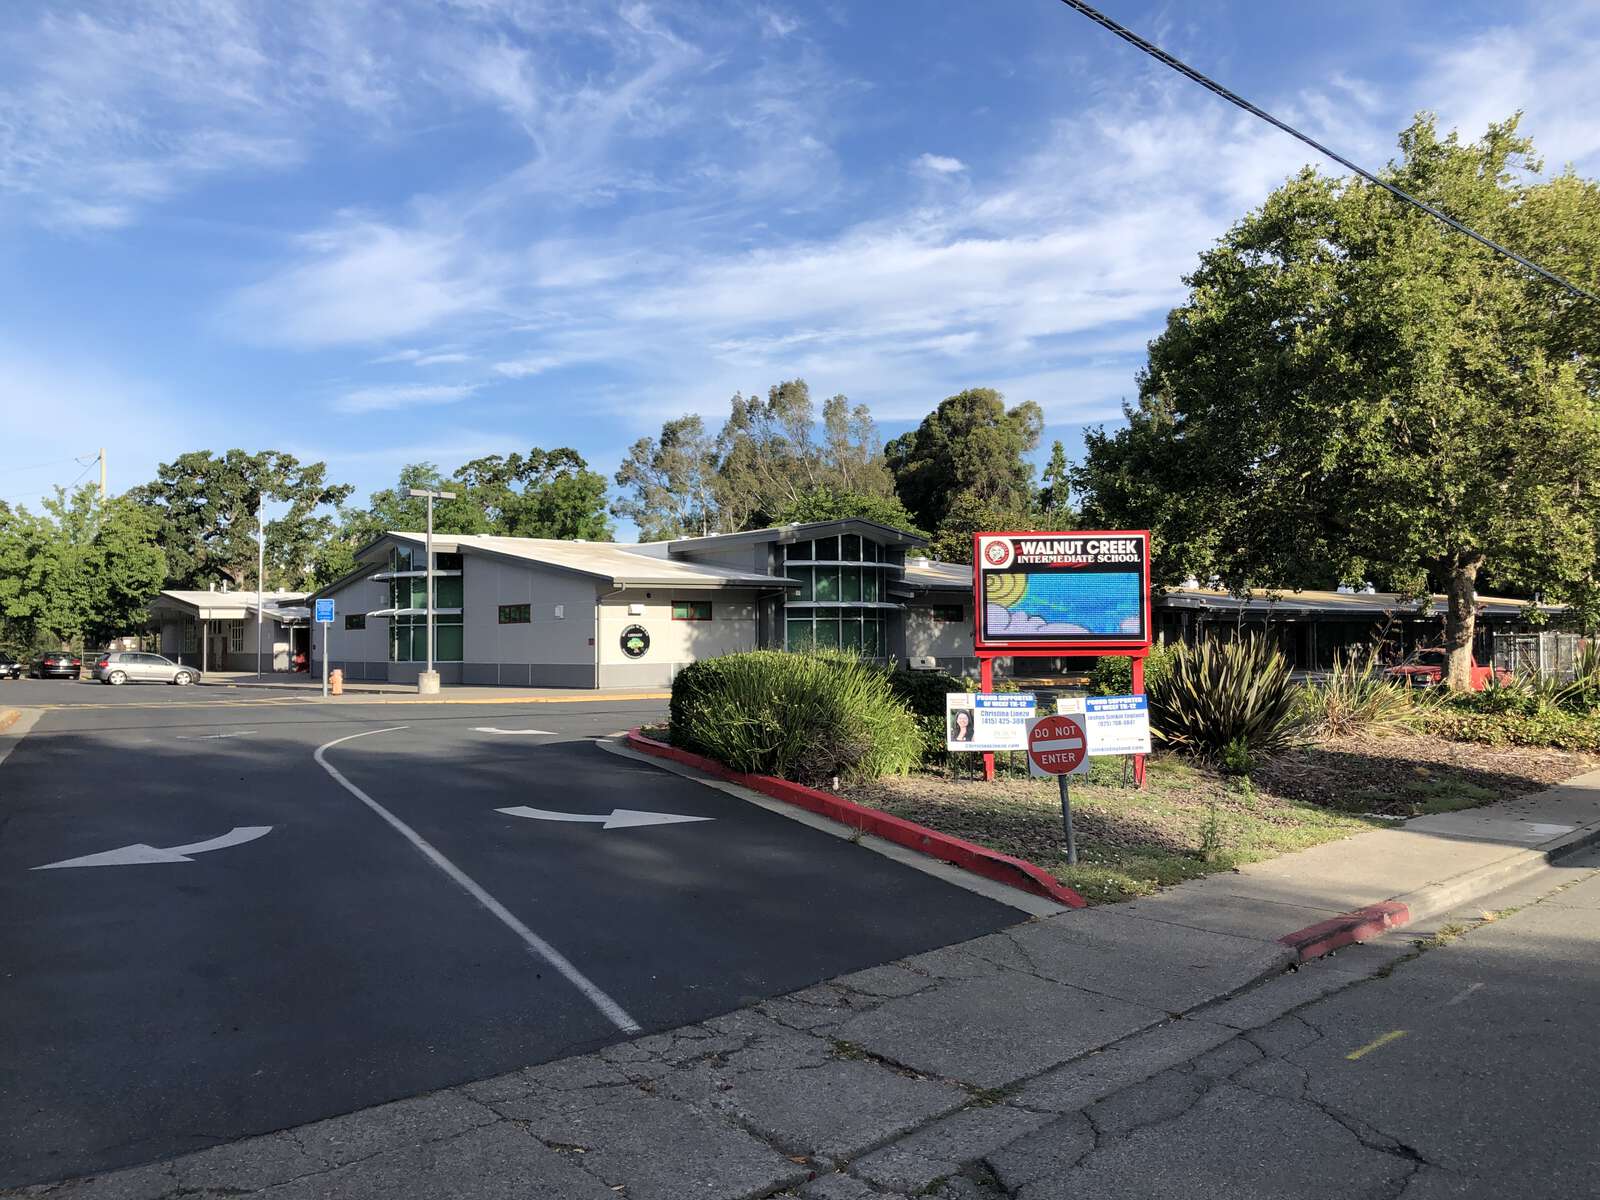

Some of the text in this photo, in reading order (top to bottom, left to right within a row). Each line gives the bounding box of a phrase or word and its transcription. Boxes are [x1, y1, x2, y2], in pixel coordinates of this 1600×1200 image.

[1020, 541, 1084, 555] WALNUT
[1086, 540, 1137, 554] CREEK
[1017, 554, 1141, 563] INTERMEDIATE SCHOOL
[1034, 725, 1076, 738] DO NOT
[1041, 752, 1076, 765] ENTER
